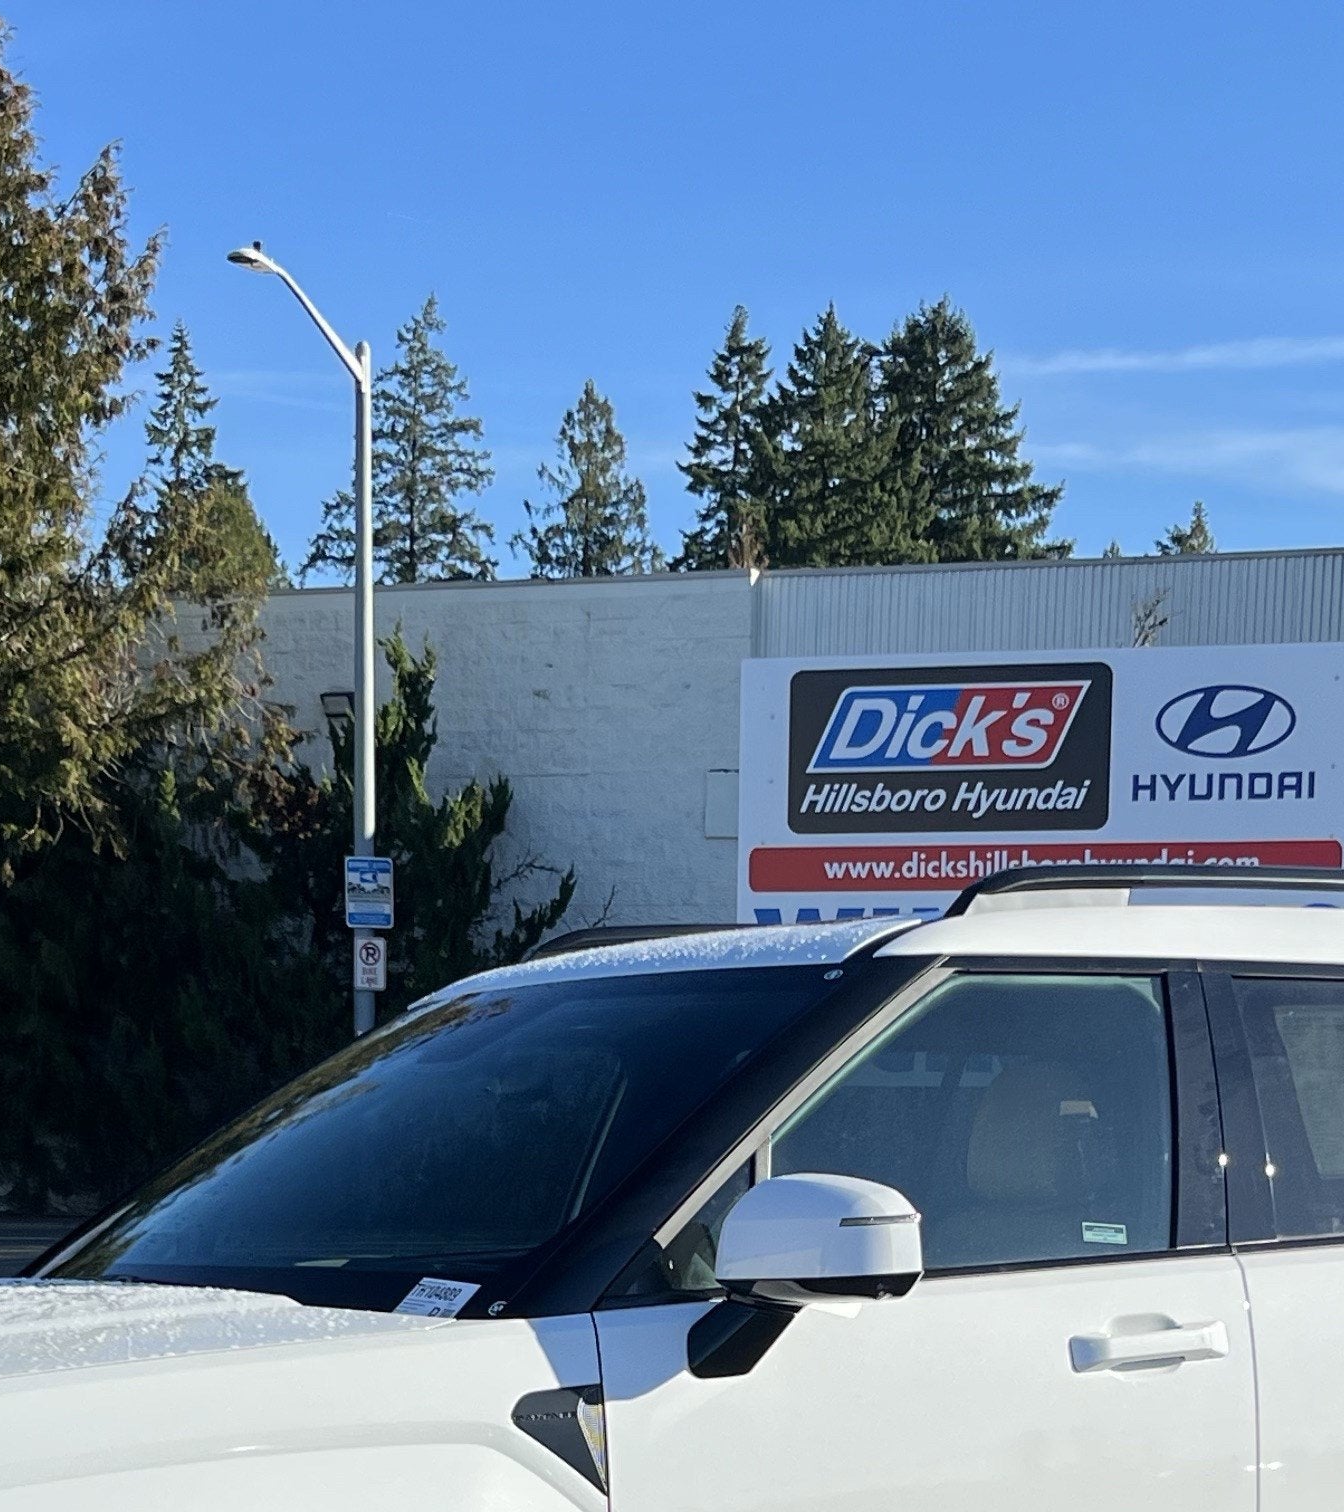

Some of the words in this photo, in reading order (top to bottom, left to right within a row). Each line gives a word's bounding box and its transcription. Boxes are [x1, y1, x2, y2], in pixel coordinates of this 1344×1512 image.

[829, 692, 1054, 760] Dick's
[800, 781, 946, 814] Hillsboro
[951, 779, 1092, 819] Hyundai
[1132, 771, 1316, 803] HYUNDAI
